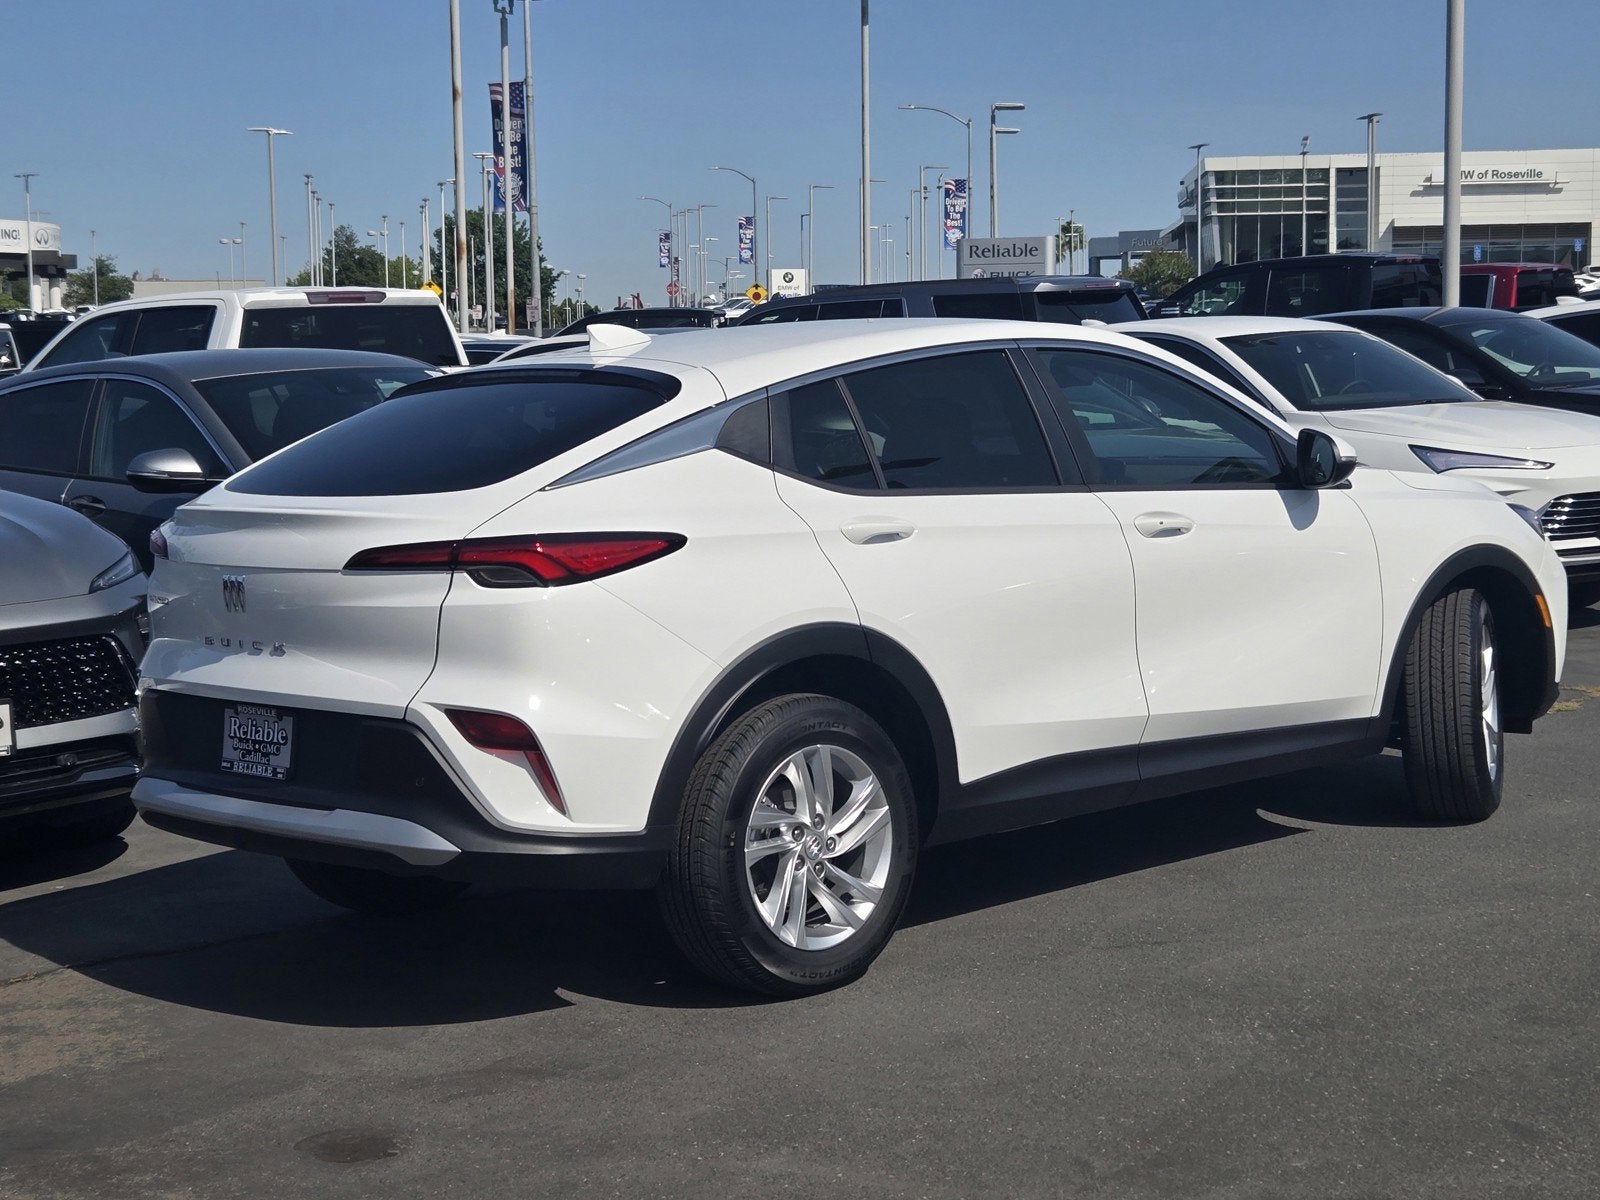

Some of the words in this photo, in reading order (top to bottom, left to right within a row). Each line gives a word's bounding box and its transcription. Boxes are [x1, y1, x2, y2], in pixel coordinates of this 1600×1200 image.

[510, 131, 521, 142] Be
[498, 155, 522, 168] Bst!
[1477, 169, 1489, 179] of
[1491, 168, 1543, 179] Roseville
[1131, 238, 1163, 247] Future
[969, 243, 1039, 259] Reliable
[204, 636, 286, 655] BUICK
[237, 704, 277, 717] ROSEVILLE
[229, 717, 287, 744] Reliable
[233, 738, 254, 751] Buick
[260, 743, 280, 755] GMC
[239, 750, 270, 764] Cadillac
[233, 761, 273, 777] RELIABLE
